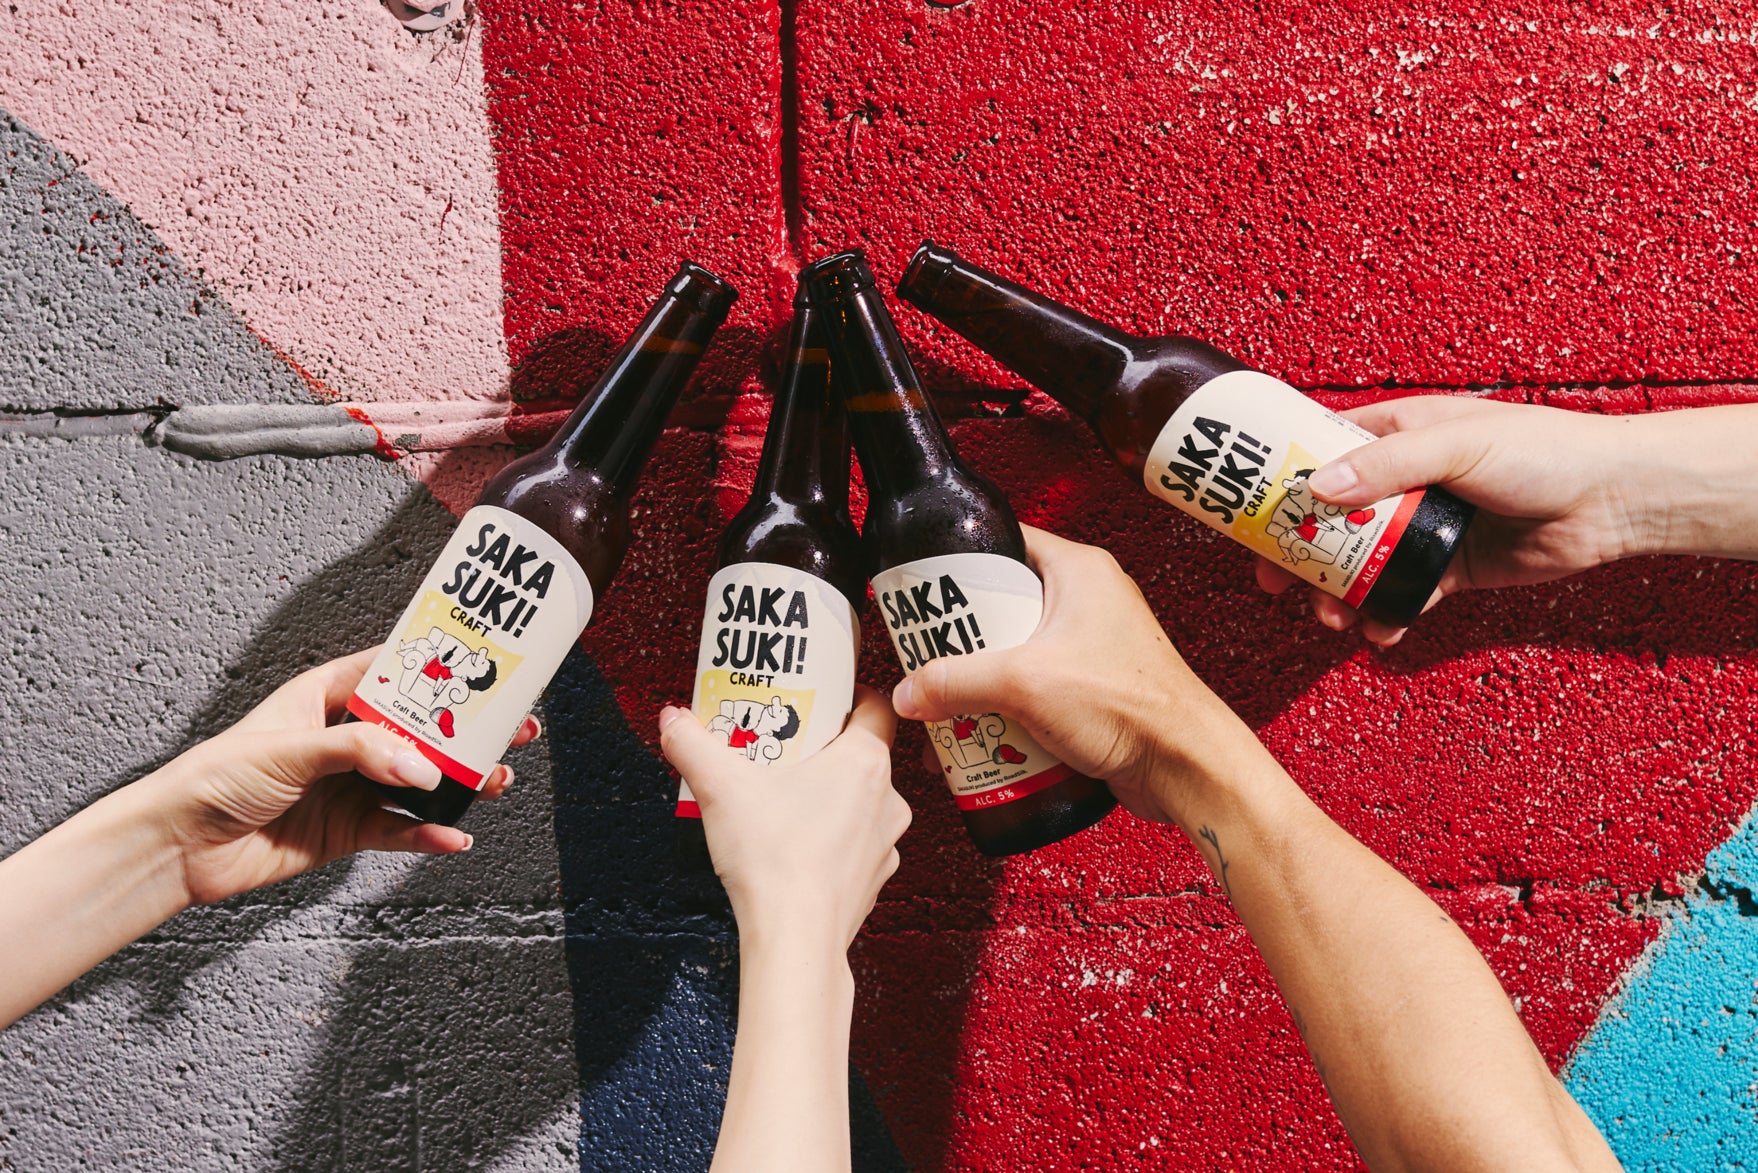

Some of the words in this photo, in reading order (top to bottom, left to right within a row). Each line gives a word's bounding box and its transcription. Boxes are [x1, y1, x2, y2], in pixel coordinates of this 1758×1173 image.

[1160, 416, 1231, 502] SAKA
[1199, 431, 1272, 524] SUKI!
[1243, 476, 1272, 517] CRAFT
[466, 523, 555, 599] SAKA
[1340, 554, 1355, 570] Craft
[1350, 536, 1365, 554] Beer
[1353, 548, 1368, 570] produced
[1362, 564, 1380, 584] ALC.
[1374, 544, 1390, 561] 5%
[441, 560, 539, 638] SUKI!
[717, 583, 809, 629] SAKA
[882, 574, 969, 630] SAKA
[450, 606, 492, 638] CRAFT
[898, 612, 986, 671] SUKI!
[712, 627, 808, 675] SUKI!
[729, 671, 775, 688] CRAFT
[392, 700, 410, 715] Craft
[409, 711, 428, 726] Beer
[392, 712, 415, 729] produced
[966, 773, 982, 783] Craft
[982, 768, 1001, 779] Beer
[974, 780, 997, 790] produced
[975, 795, 996, 807] ALC.
[997, 788, 1015, 801] 5%
